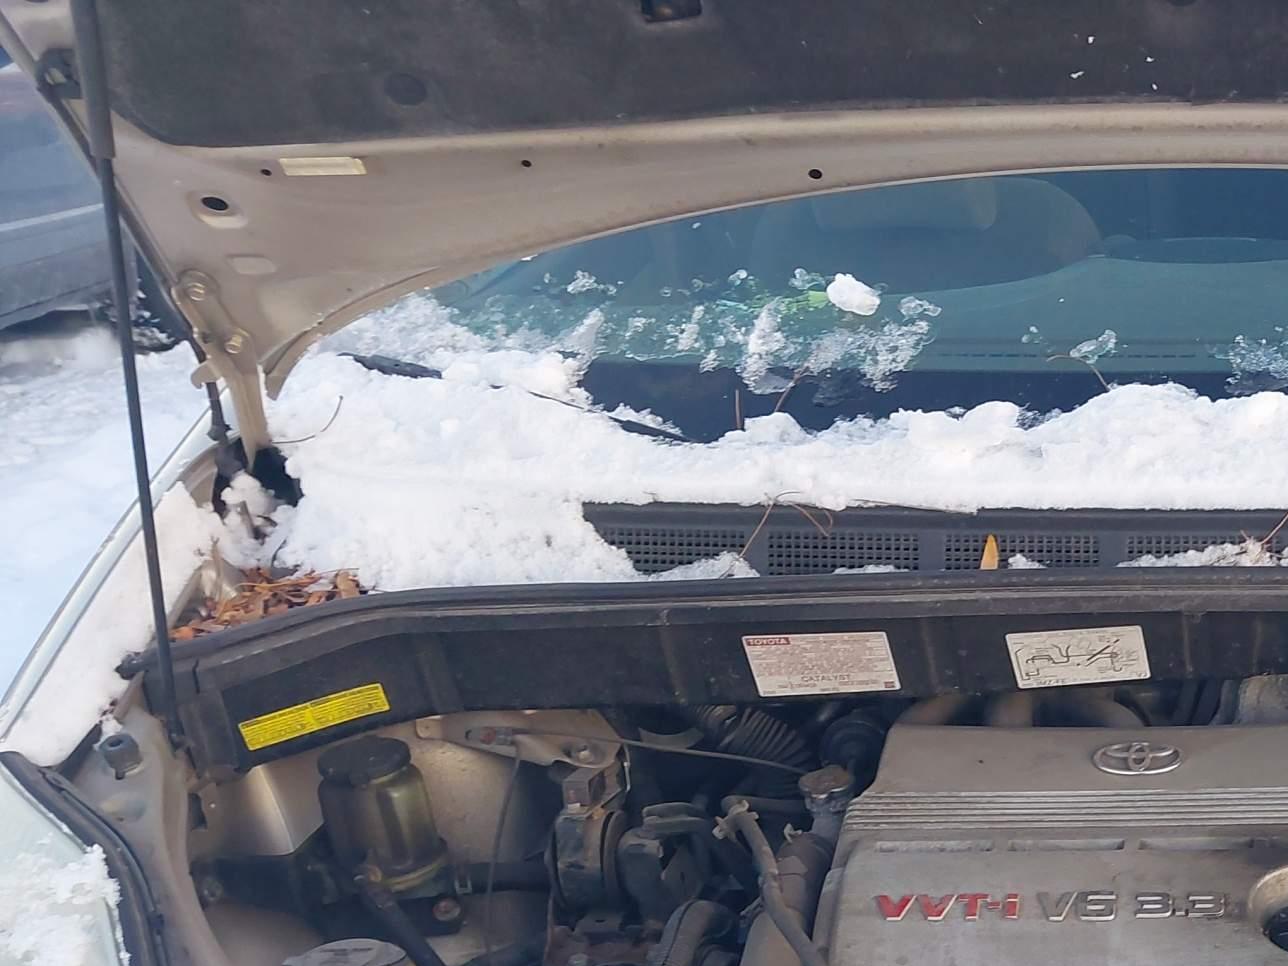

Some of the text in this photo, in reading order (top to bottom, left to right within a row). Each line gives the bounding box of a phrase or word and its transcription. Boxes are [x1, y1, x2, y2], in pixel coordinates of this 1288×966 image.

[747, 637, 789, 646] TOYOTA
[801, 674, 851, 682] CATALYST
[1037, 890, 1117, 922] V6
[1135, 892, 1226, 920] 3.3
